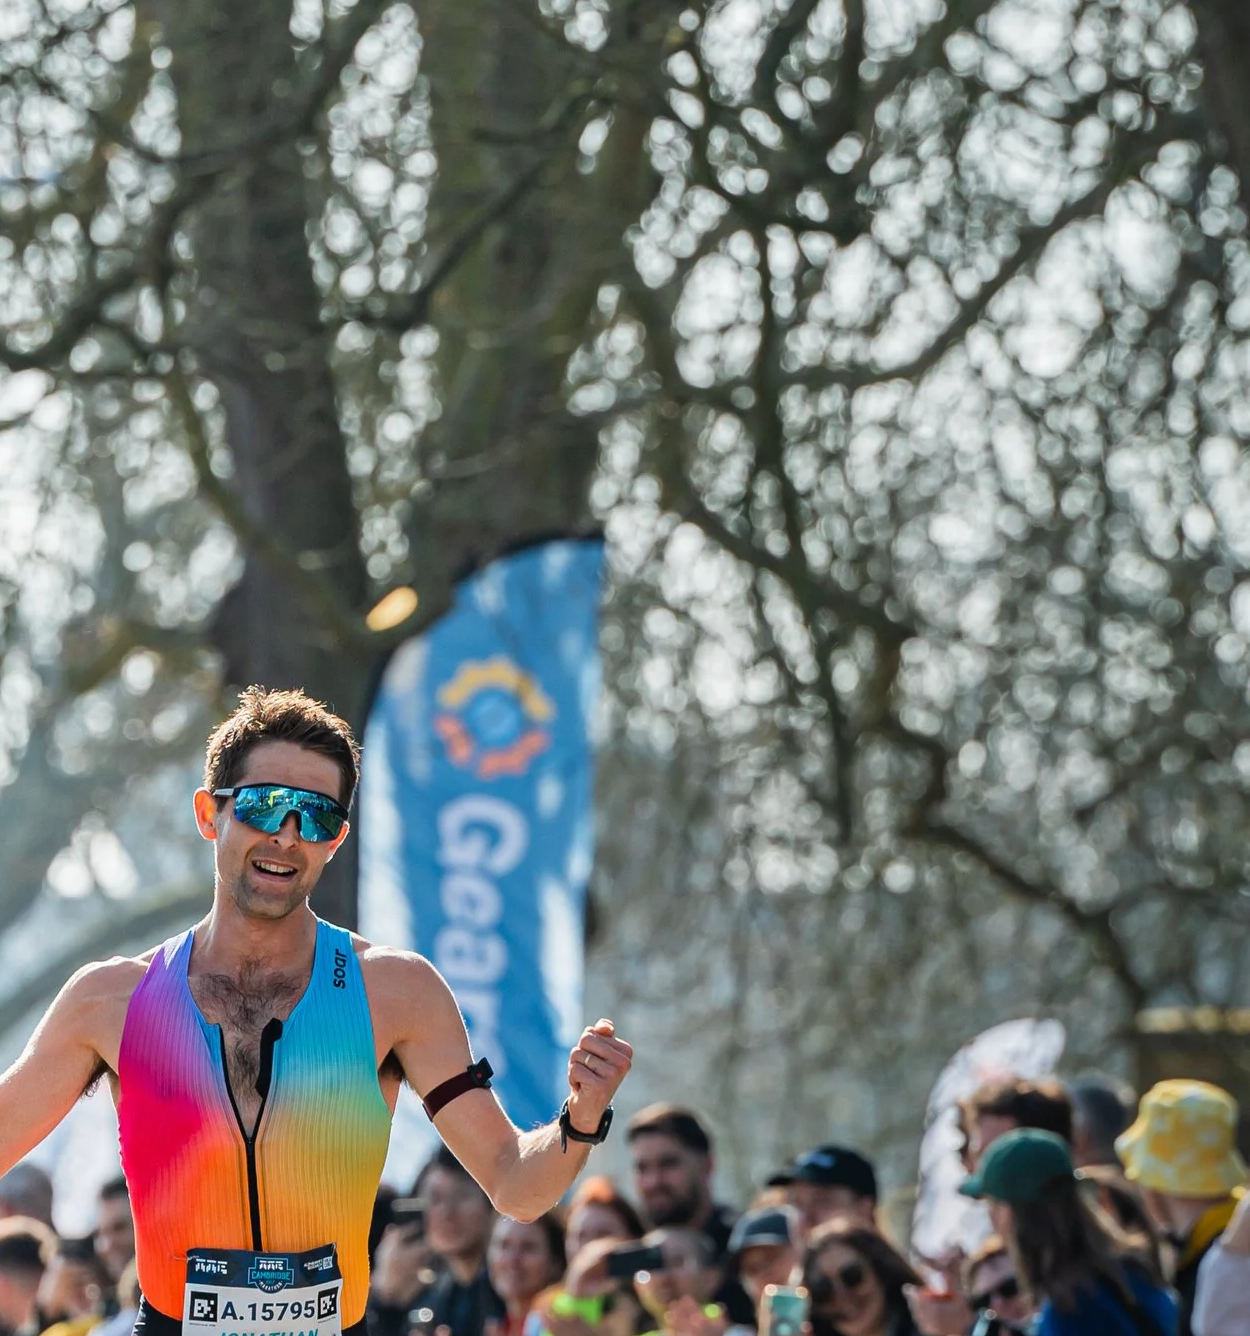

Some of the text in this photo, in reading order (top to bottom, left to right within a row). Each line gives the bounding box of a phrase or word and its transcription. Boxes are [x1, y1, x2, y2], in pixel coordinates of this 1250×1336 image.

[333, 948, 347, 990] soar
[251, 1270, 291, 1281] CAMBRIDGE
[220, 1300, 315, 1321] A.15795
